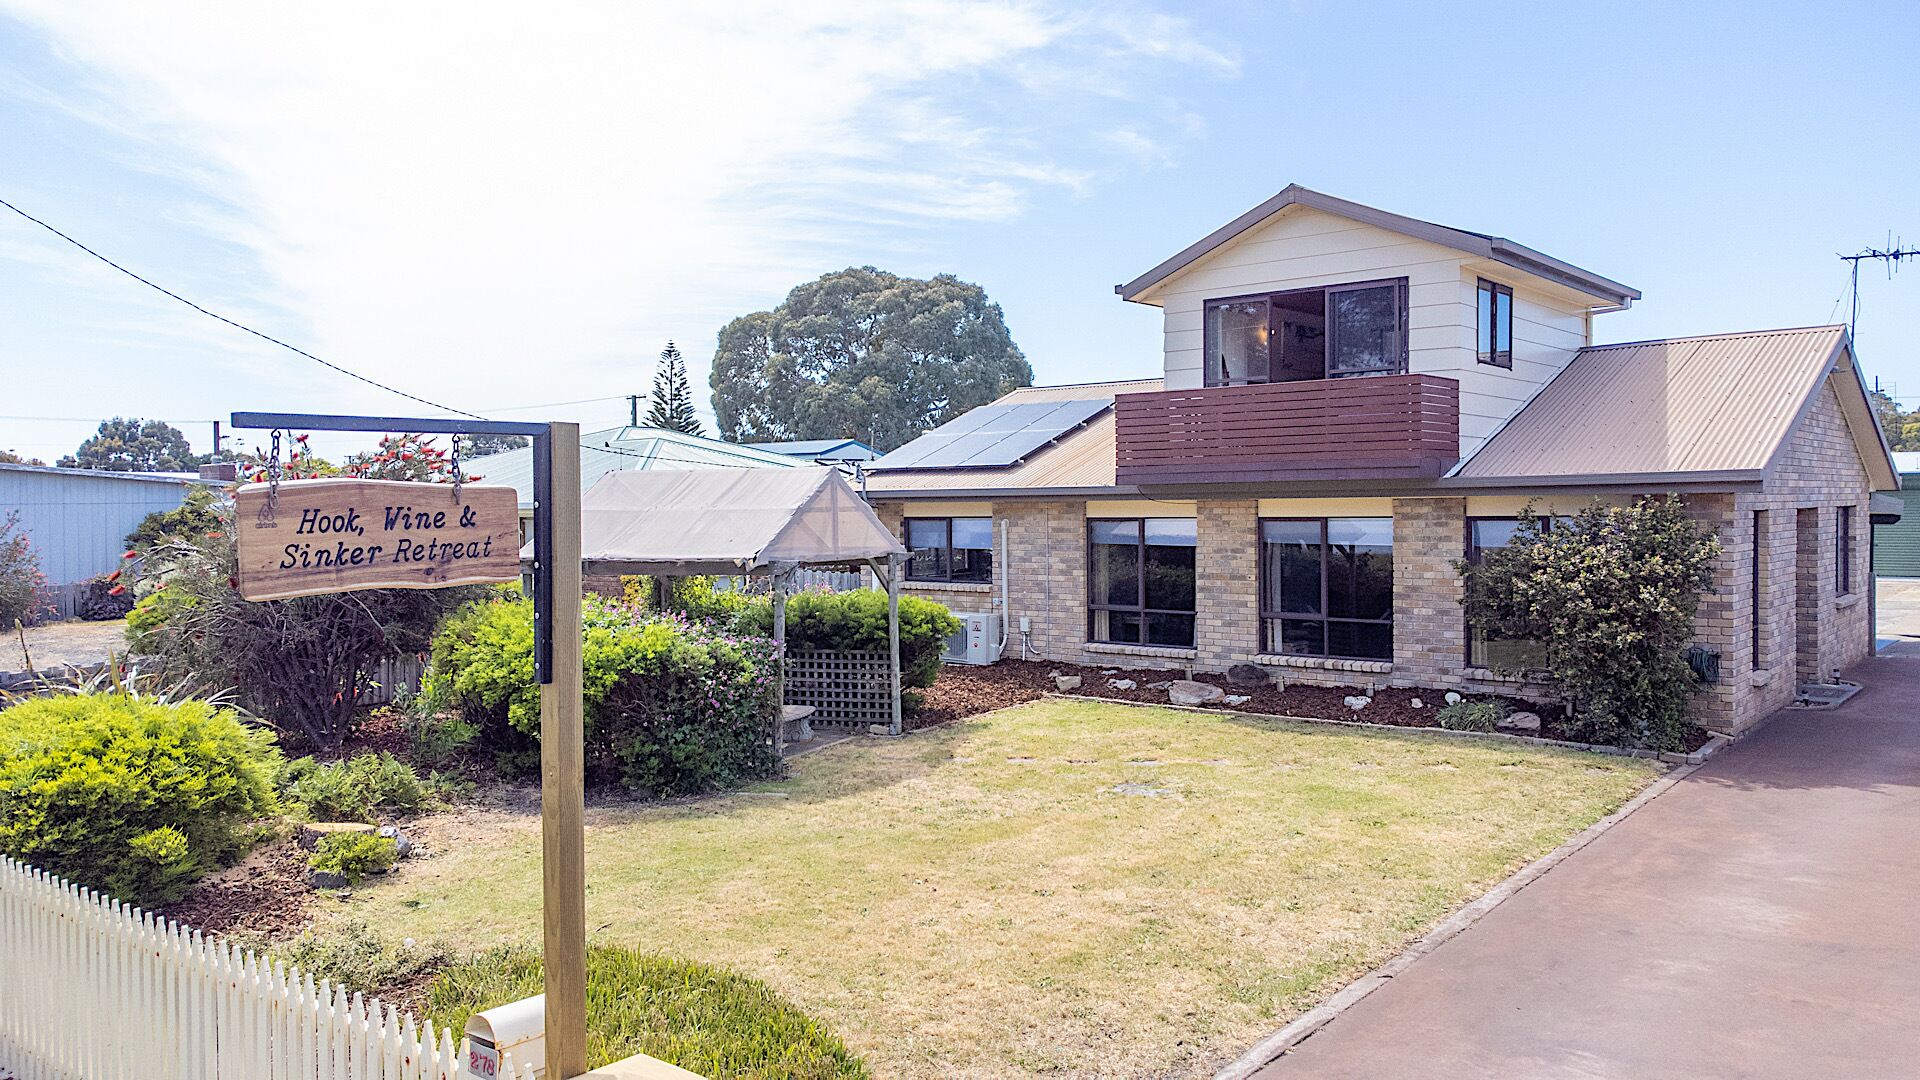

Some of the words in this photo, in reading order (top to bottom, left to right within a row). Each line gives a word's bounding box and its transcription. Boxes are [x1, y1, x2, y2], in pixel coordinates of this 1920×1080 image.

[296, 507, 364, 536] Hook,
[384, 506, 446, 531] Wine
[459, 505, 477, 528] &
[280, 541, 383, 569] Sinker
[392, 535, 492, 563] Retreat
[470, 1051, 496, 1076] 278
